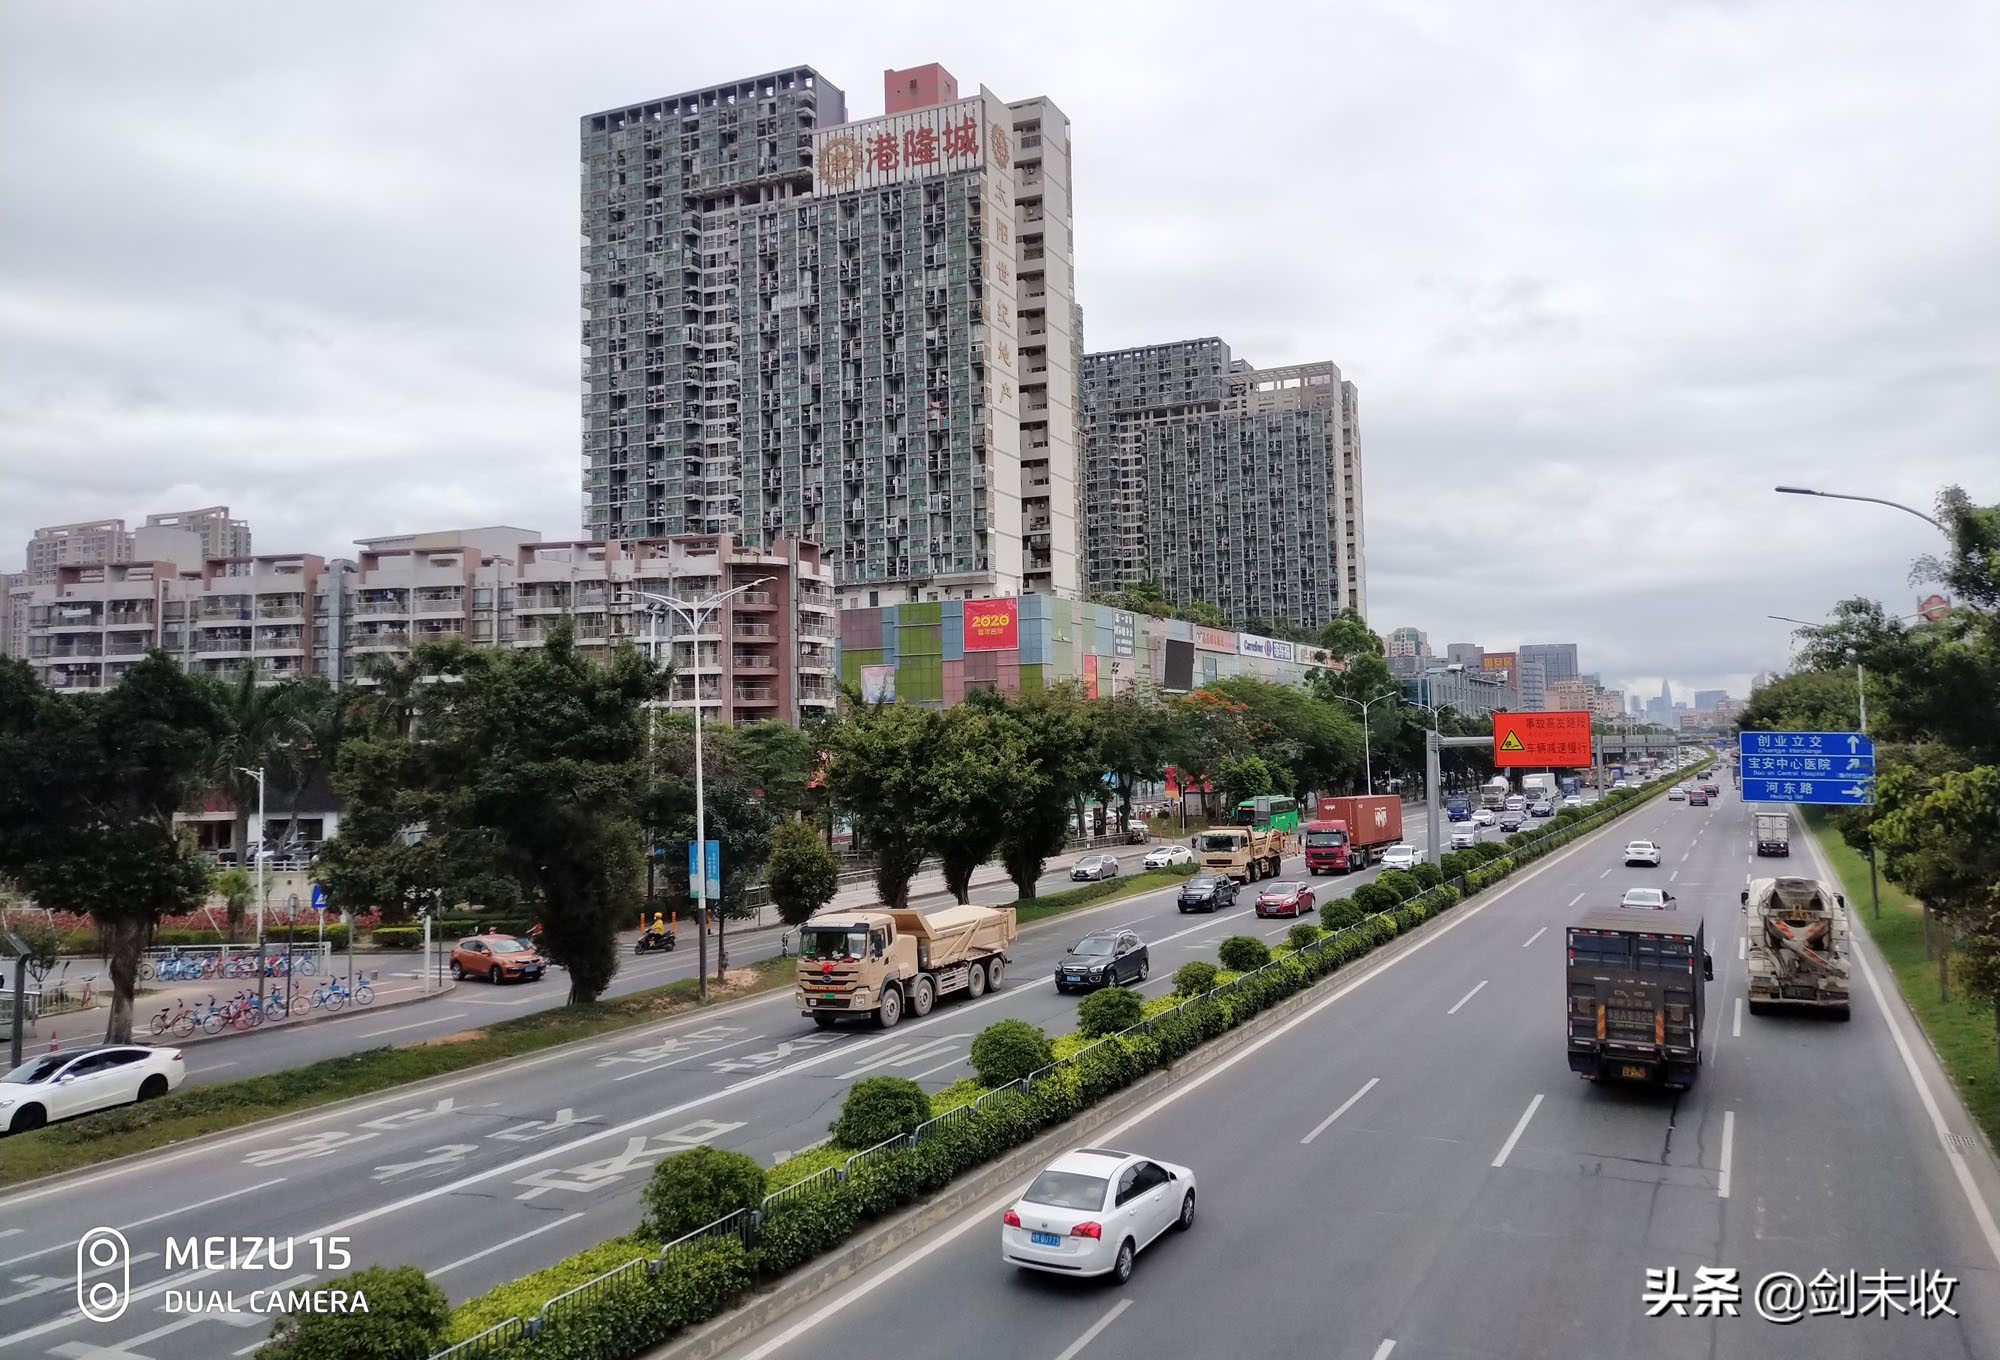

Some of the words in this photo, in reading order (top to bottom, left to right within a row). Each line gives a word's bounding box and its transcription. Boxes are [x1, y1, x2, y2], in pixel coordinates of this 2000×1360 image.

[865, 116, 979, 173] 港隆城
[972, 613, 1010, 628] 2020
[1526, 717, 1586, 730] 事故高发路段
[1757, 735, 1823, 748] 创业立交
[1526, 742, 1588, 755] 车辆减速慢行
[1748, 757, 1832, 770] 宝安中心医院
[1766, 781, 1814, 795] 河东路
